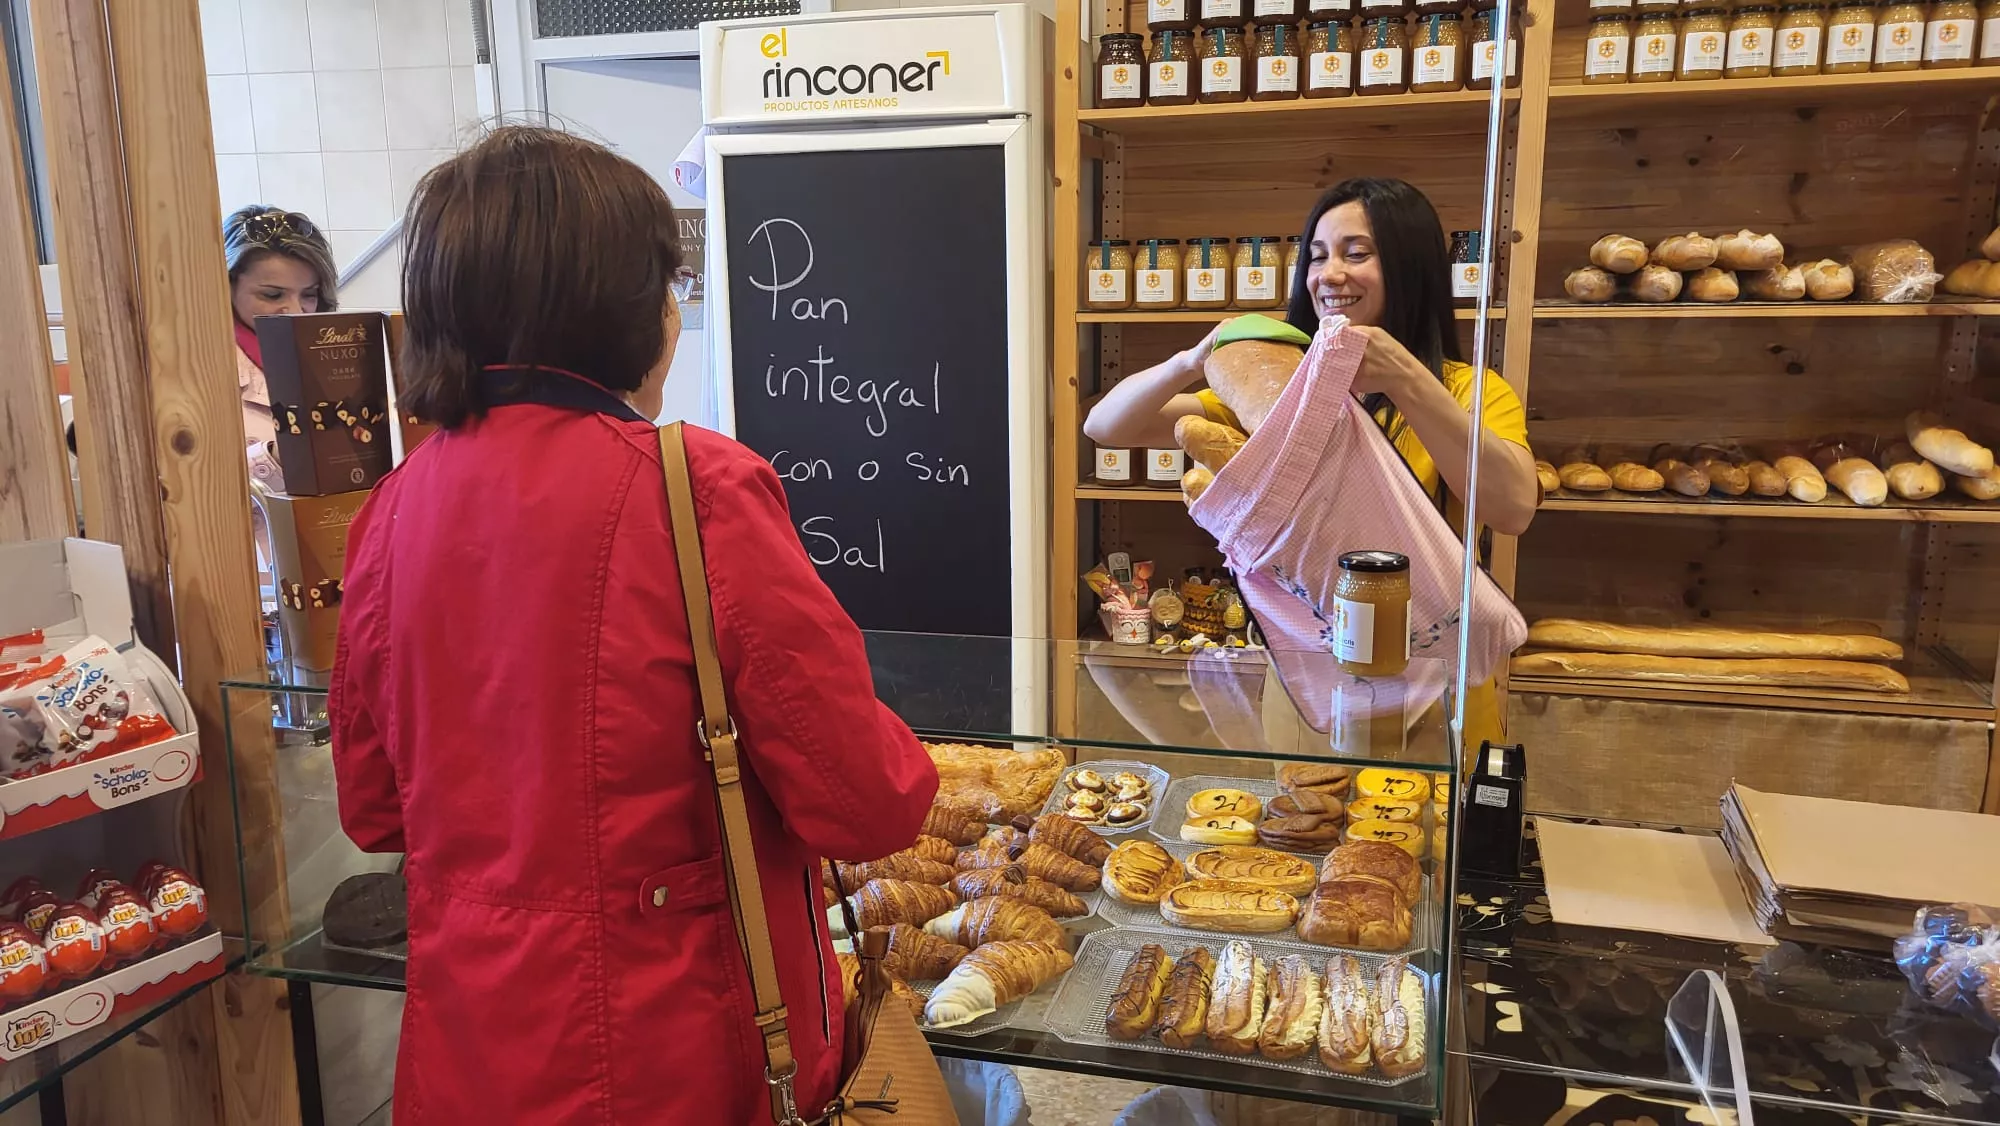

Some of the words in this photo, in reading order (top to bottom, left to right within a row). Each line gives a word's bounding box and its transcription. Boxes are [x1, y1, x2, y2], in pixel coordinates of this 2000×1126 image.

[760, 27, 788, 58] el
[763, 61, 941, 98] rinconer
[764, 100, 829, 112] PRODUCTOS
[833, 97, 899, 110] ARTESANOS
[748, 218, 849, 324] Pan
[315, 326, 355, 345] Lindt
[765, 344, 941, 437] integral
[858, 460, 880, 481] o
[800, 515, 884, 573] Sal
[73, 683, 109, 711] Bons
[111, 782, 141, 798] Bons
